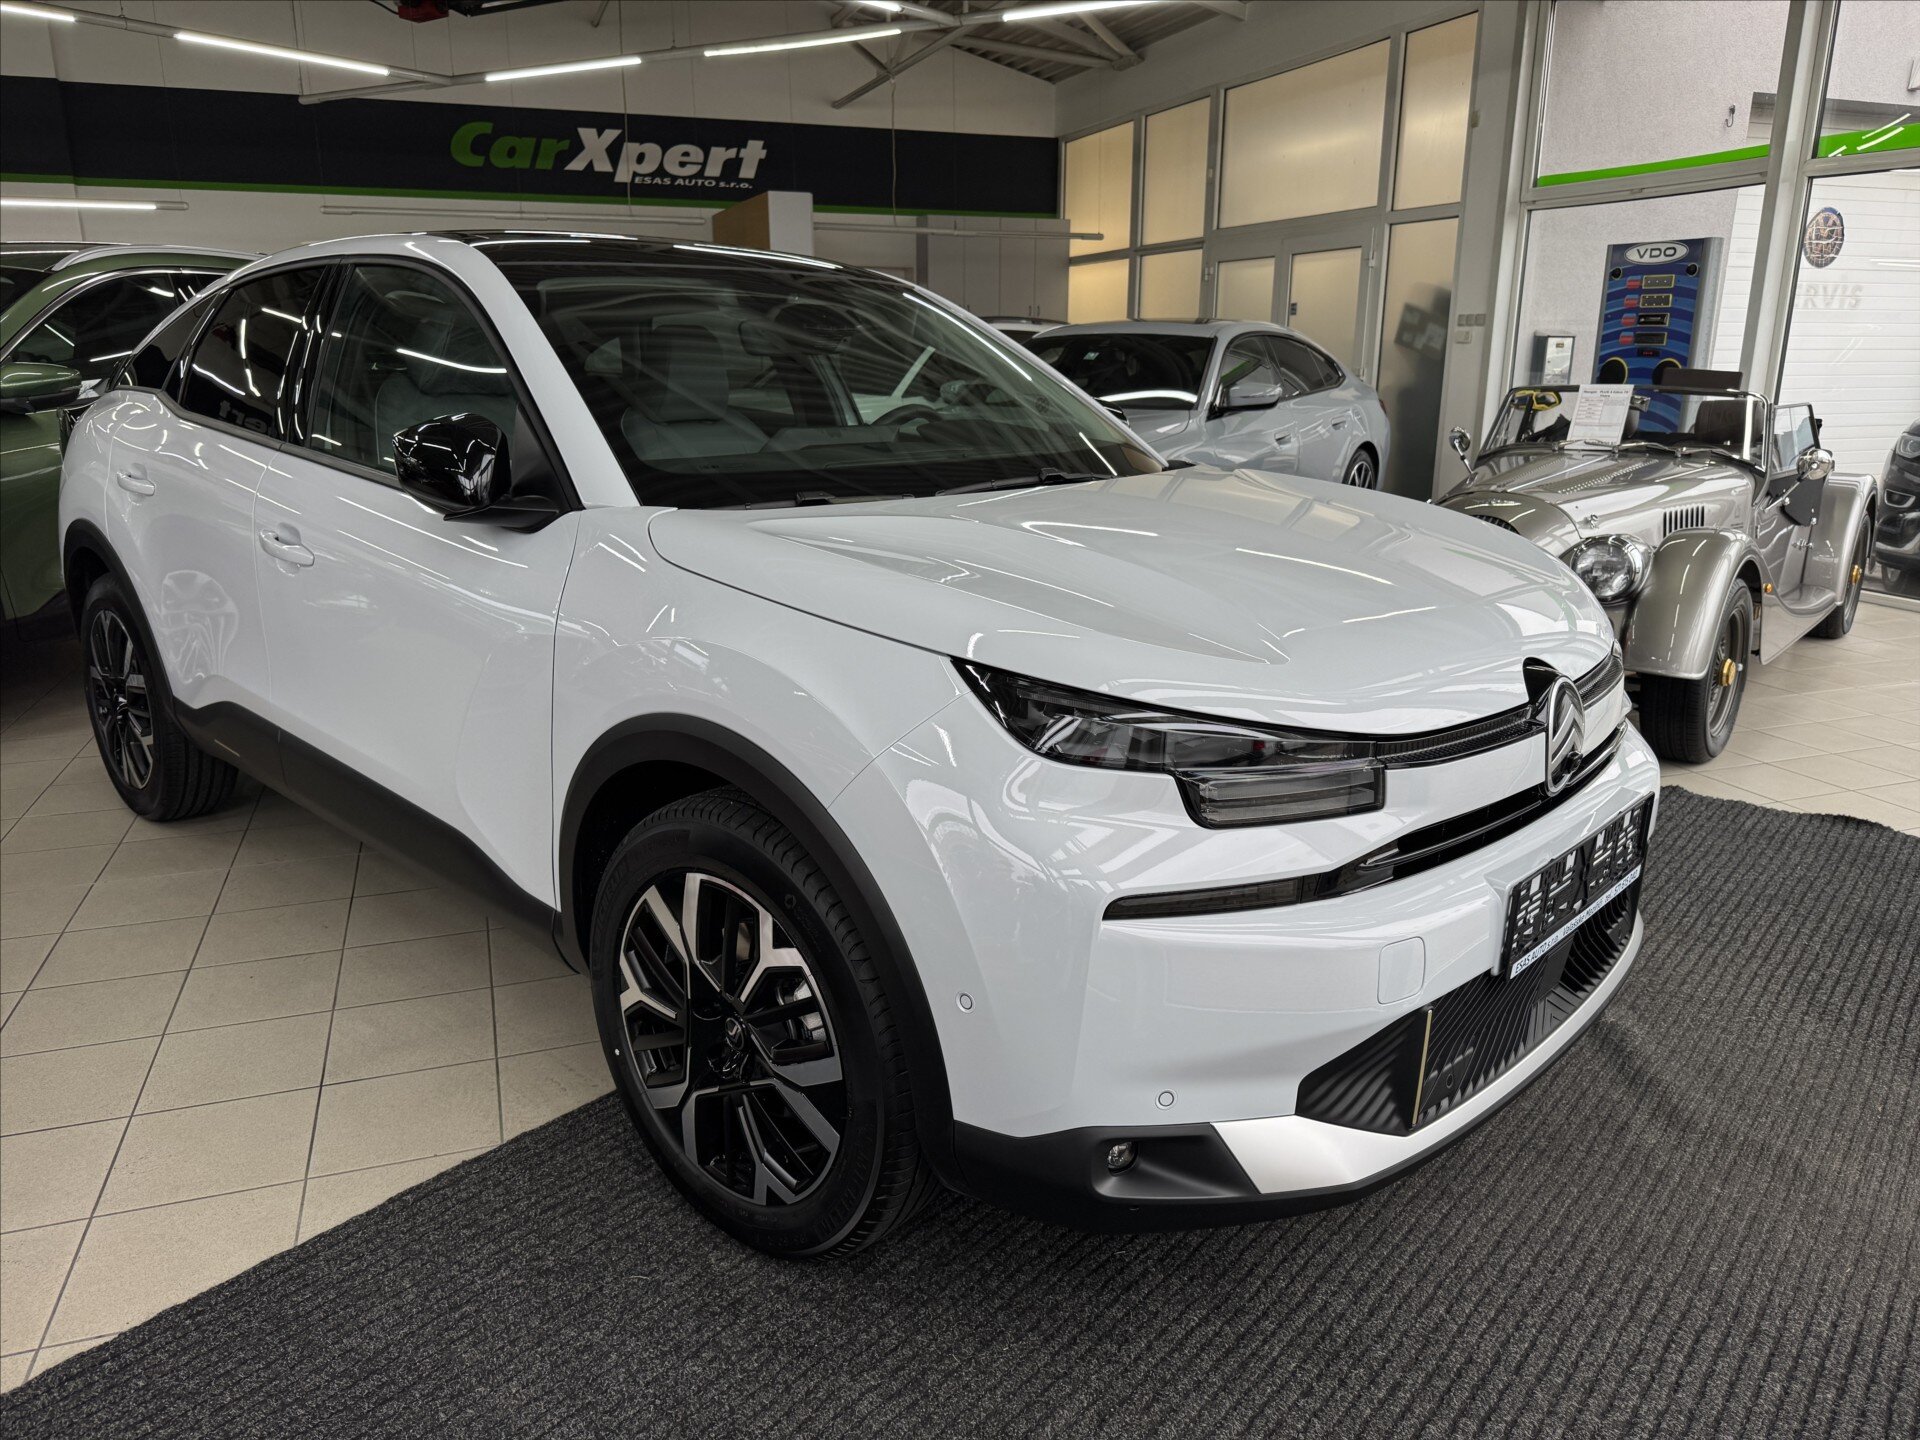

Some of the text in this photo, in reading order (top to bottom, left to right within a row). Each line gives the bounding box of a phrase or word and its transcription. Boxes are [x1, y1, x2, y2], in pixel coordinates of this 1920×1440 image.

[450, 121, 767, 183] CarXpert
[634, 176, 753, 189] ESAS AUTO s.r.o.
[1636, 246, 1677, 259] VDO
[1515, 954, 1531, 974] ESAS
[1530, 942, 1547, 962] AUTO
